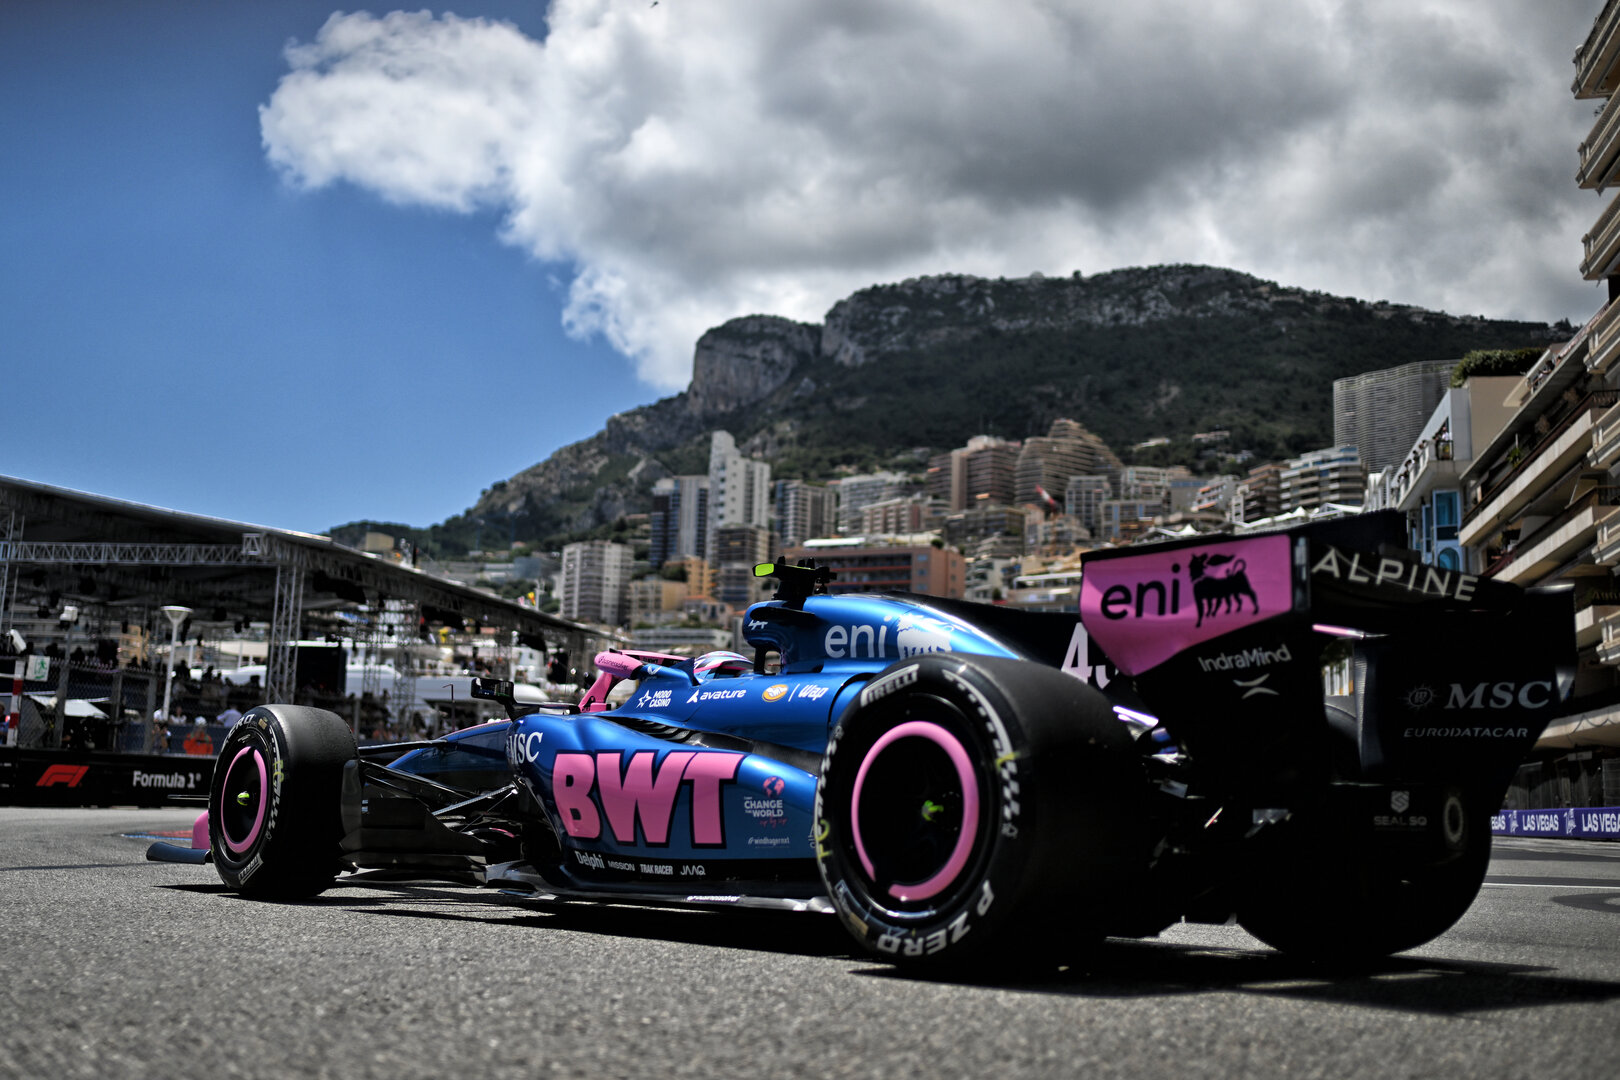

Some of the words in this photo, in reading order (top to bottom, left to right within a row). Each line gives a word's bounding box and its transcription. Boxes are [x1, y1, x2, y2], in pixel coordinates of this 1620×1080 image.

[1311, 548, 1478, 602] ALPINE
[1101, 563, 1181, 620] eni
[824, 615, 891, 659] eni
[1198, 643, 1292, 672] IndraMind
[653, 690, 672, 698] MODO
[798, 684, 829, 701] Wap
[860, 663, 920, 708] PIRELLI
[1443, 680, 1552, 709] MSC
[649, 698, 671, 708] CASINO
[700, 690, 746, 700] avature
[1403, 727, 1528, 738] EURODATACAR
[132, 770, 185, 788] Formula
[552, 751, 745, 845] BWT
[744, 800, 783, 809] CHANGE
[753, 809, 784, 818] WORLD
[1491, 815, 1506, 830] EGAS
[1522, 815, 1535, 831] LAS
[1536, 815, 1559, 831] VEGAS
[1582, 814, 1598, 832] LAS
[574, 850, 605, 870] Delphi
[607, 861, 635, 871] MISSION
[640, 864, 654, 874] TRAK
[654, 865, 673, 875] RACER
[976, 879, 995, 917] P
[876, 911, 971, 956] ZERO
